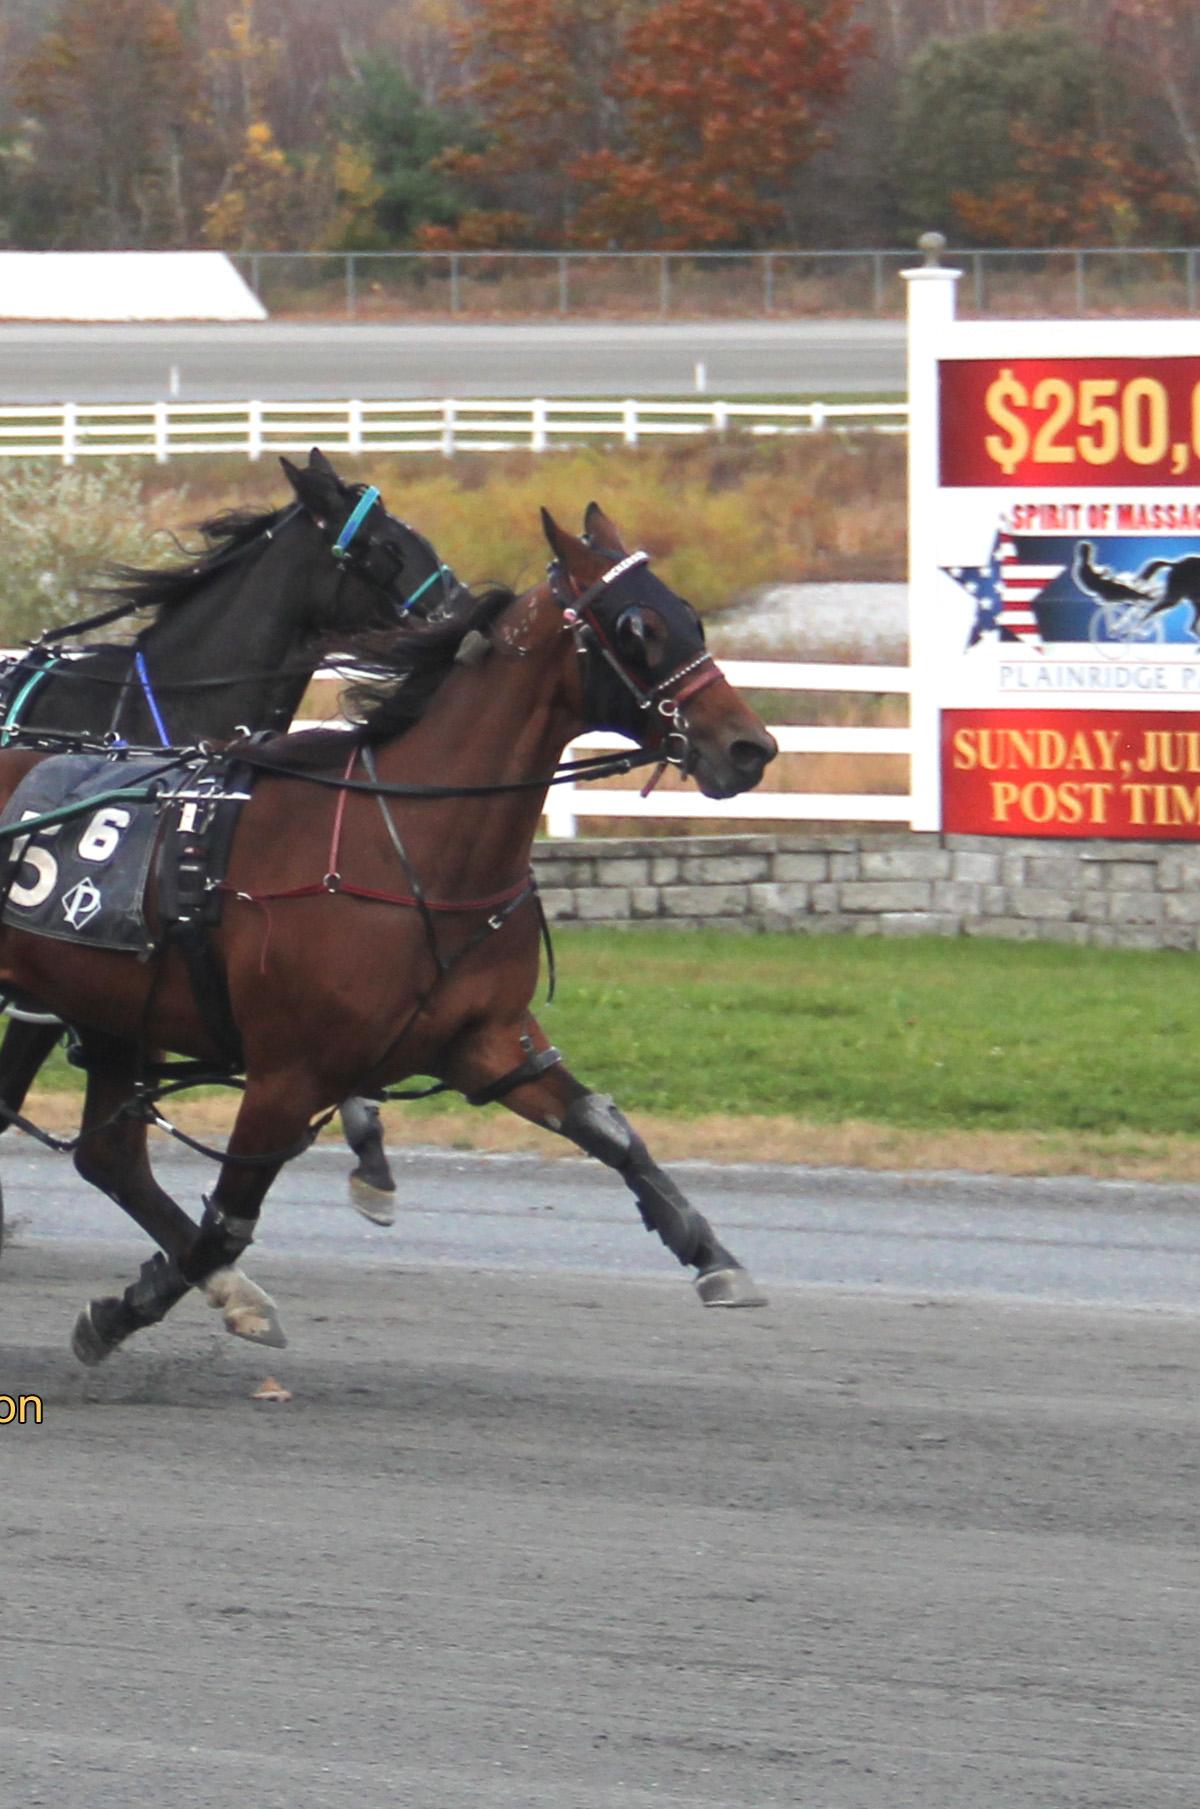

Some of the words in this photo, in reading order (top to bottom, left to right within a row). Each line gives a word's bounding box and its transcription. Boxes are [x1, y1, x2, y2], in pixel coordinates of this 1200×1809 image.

[985, 369, 1200, 476] $250,
[1012, 503, 1081, 530] SPIRIT
[1086, 503, 1110, 530] OF
[1000, 665, 1168, 690] PLAINRIDGE
[1182, 667, 1200, 690] P
[953, 728, 1133, 779] SUNDAY,
[991, 780, 1112, 823] POST
[7, 809, 62, 907] 5
[78, 807, 130, 862] 6
